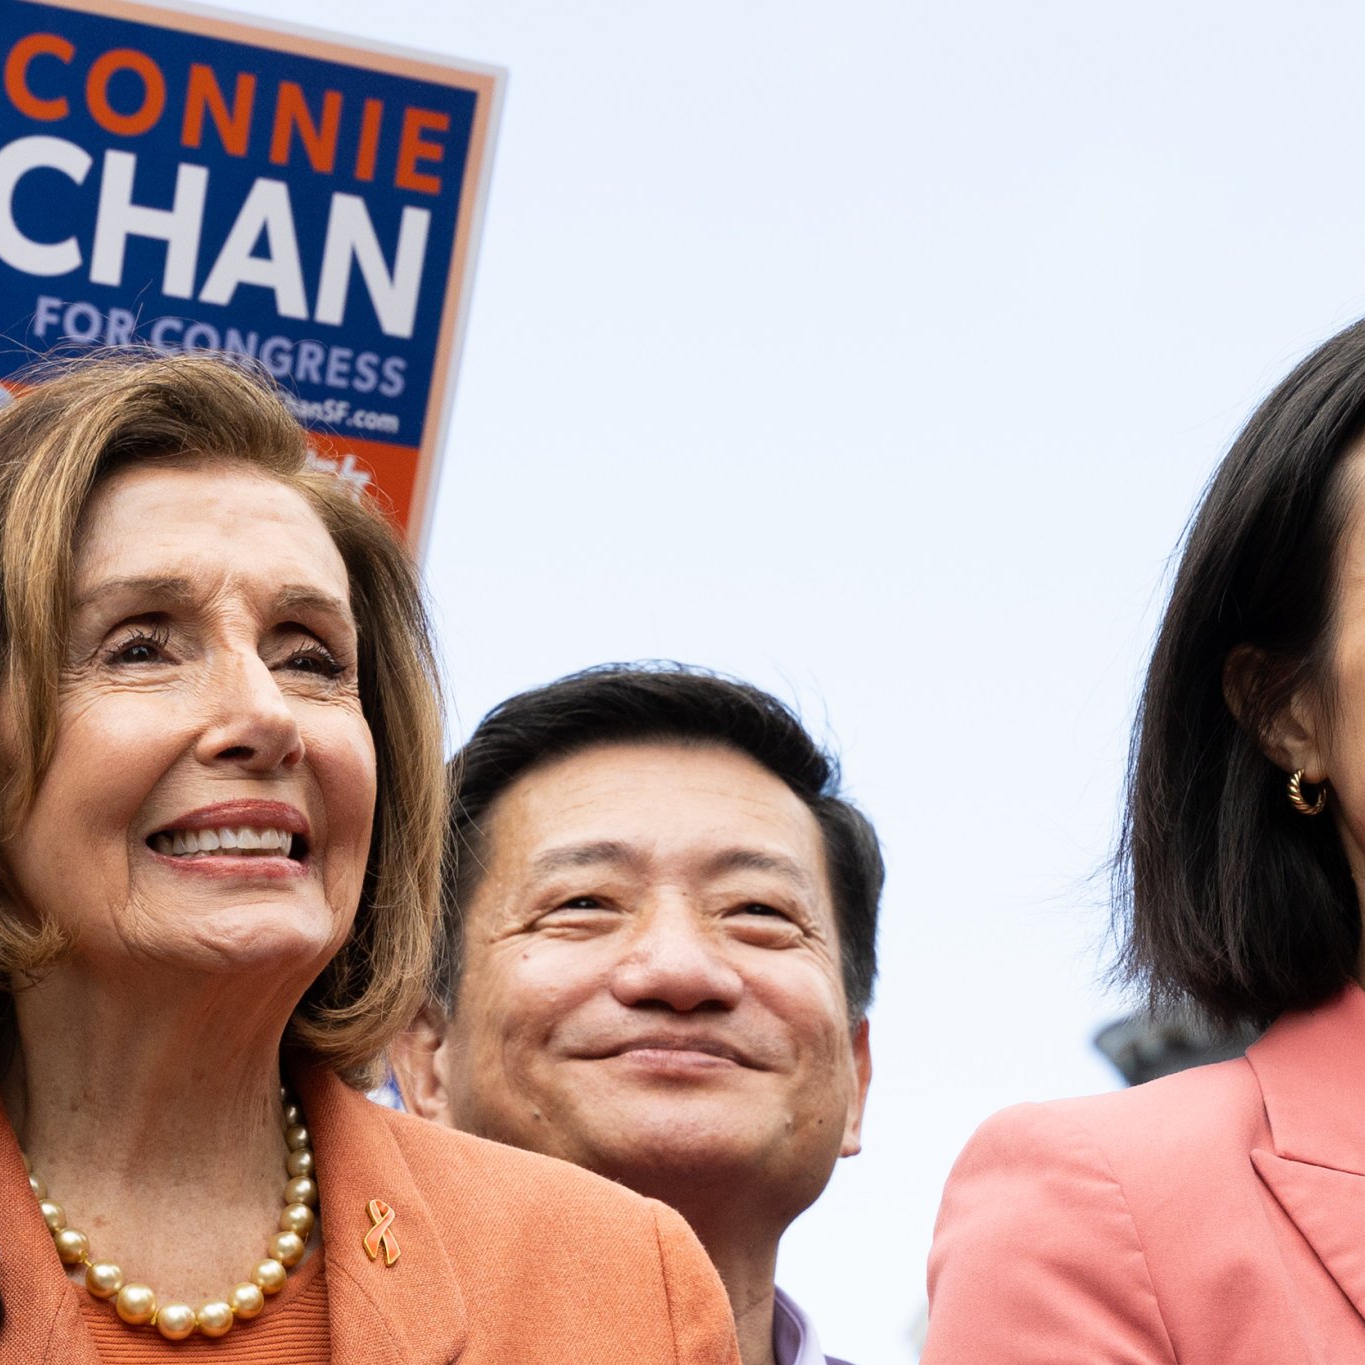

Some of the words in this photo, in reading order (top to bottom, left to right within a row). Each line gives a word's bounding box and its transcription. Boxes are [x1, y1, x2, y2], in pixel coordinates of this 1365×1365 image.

[4, 33, 451, 195] CONNIE
[33, 295, 135, 345] FOR
[150, 316, 407, 398] CONGRESS
